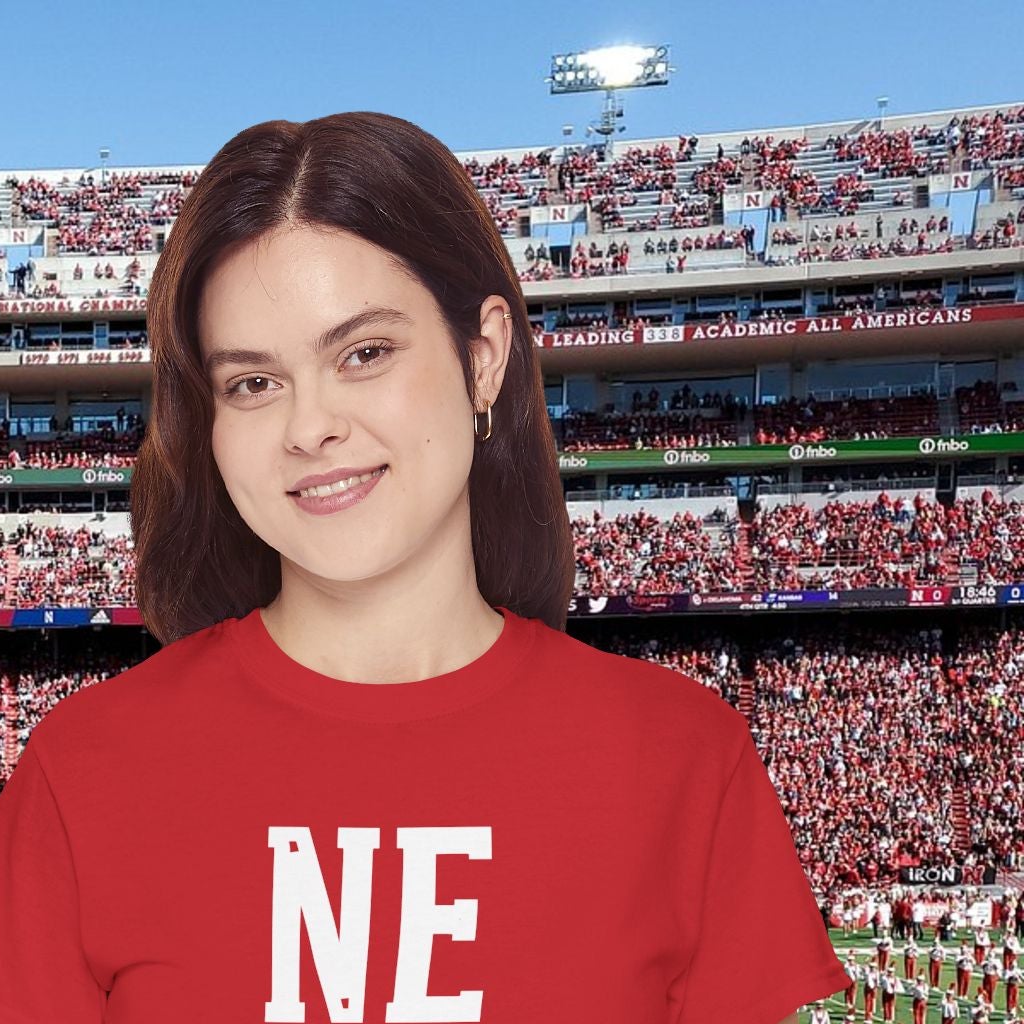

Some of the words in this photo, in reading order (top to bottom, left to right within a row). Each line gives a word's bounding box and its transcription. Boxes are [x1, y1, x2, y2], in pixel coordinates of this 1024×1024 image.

[953, 175, 969, 189] N
[746, 194, 760, 207] N
[552, 207, 566, 220] N
[12, 230, 25, 243] N
[552, 331, 635, 347] LEADING
[692, 321, 797, 339] ACADEMIC
[805, 318, 843, 333] ALL
[852, 308, 973, 329] AMERICANS
[937, 437, 969, 451] fnbo
[680, 450, 710, 464] fnbo
[805, 444, 837, 458] fnbo
[98, 470, 125, 482] fnbo
[911, 590, 924, 601] N
[959, 586, 997, 598] 18:46
[962, 597, 996, 605] QUARTER
[44, 611, 54, 624] N
[908, 865, 956, 882] IRON
[961, 864, 986, 885] N
[264, 826, 492, 1023] NE
